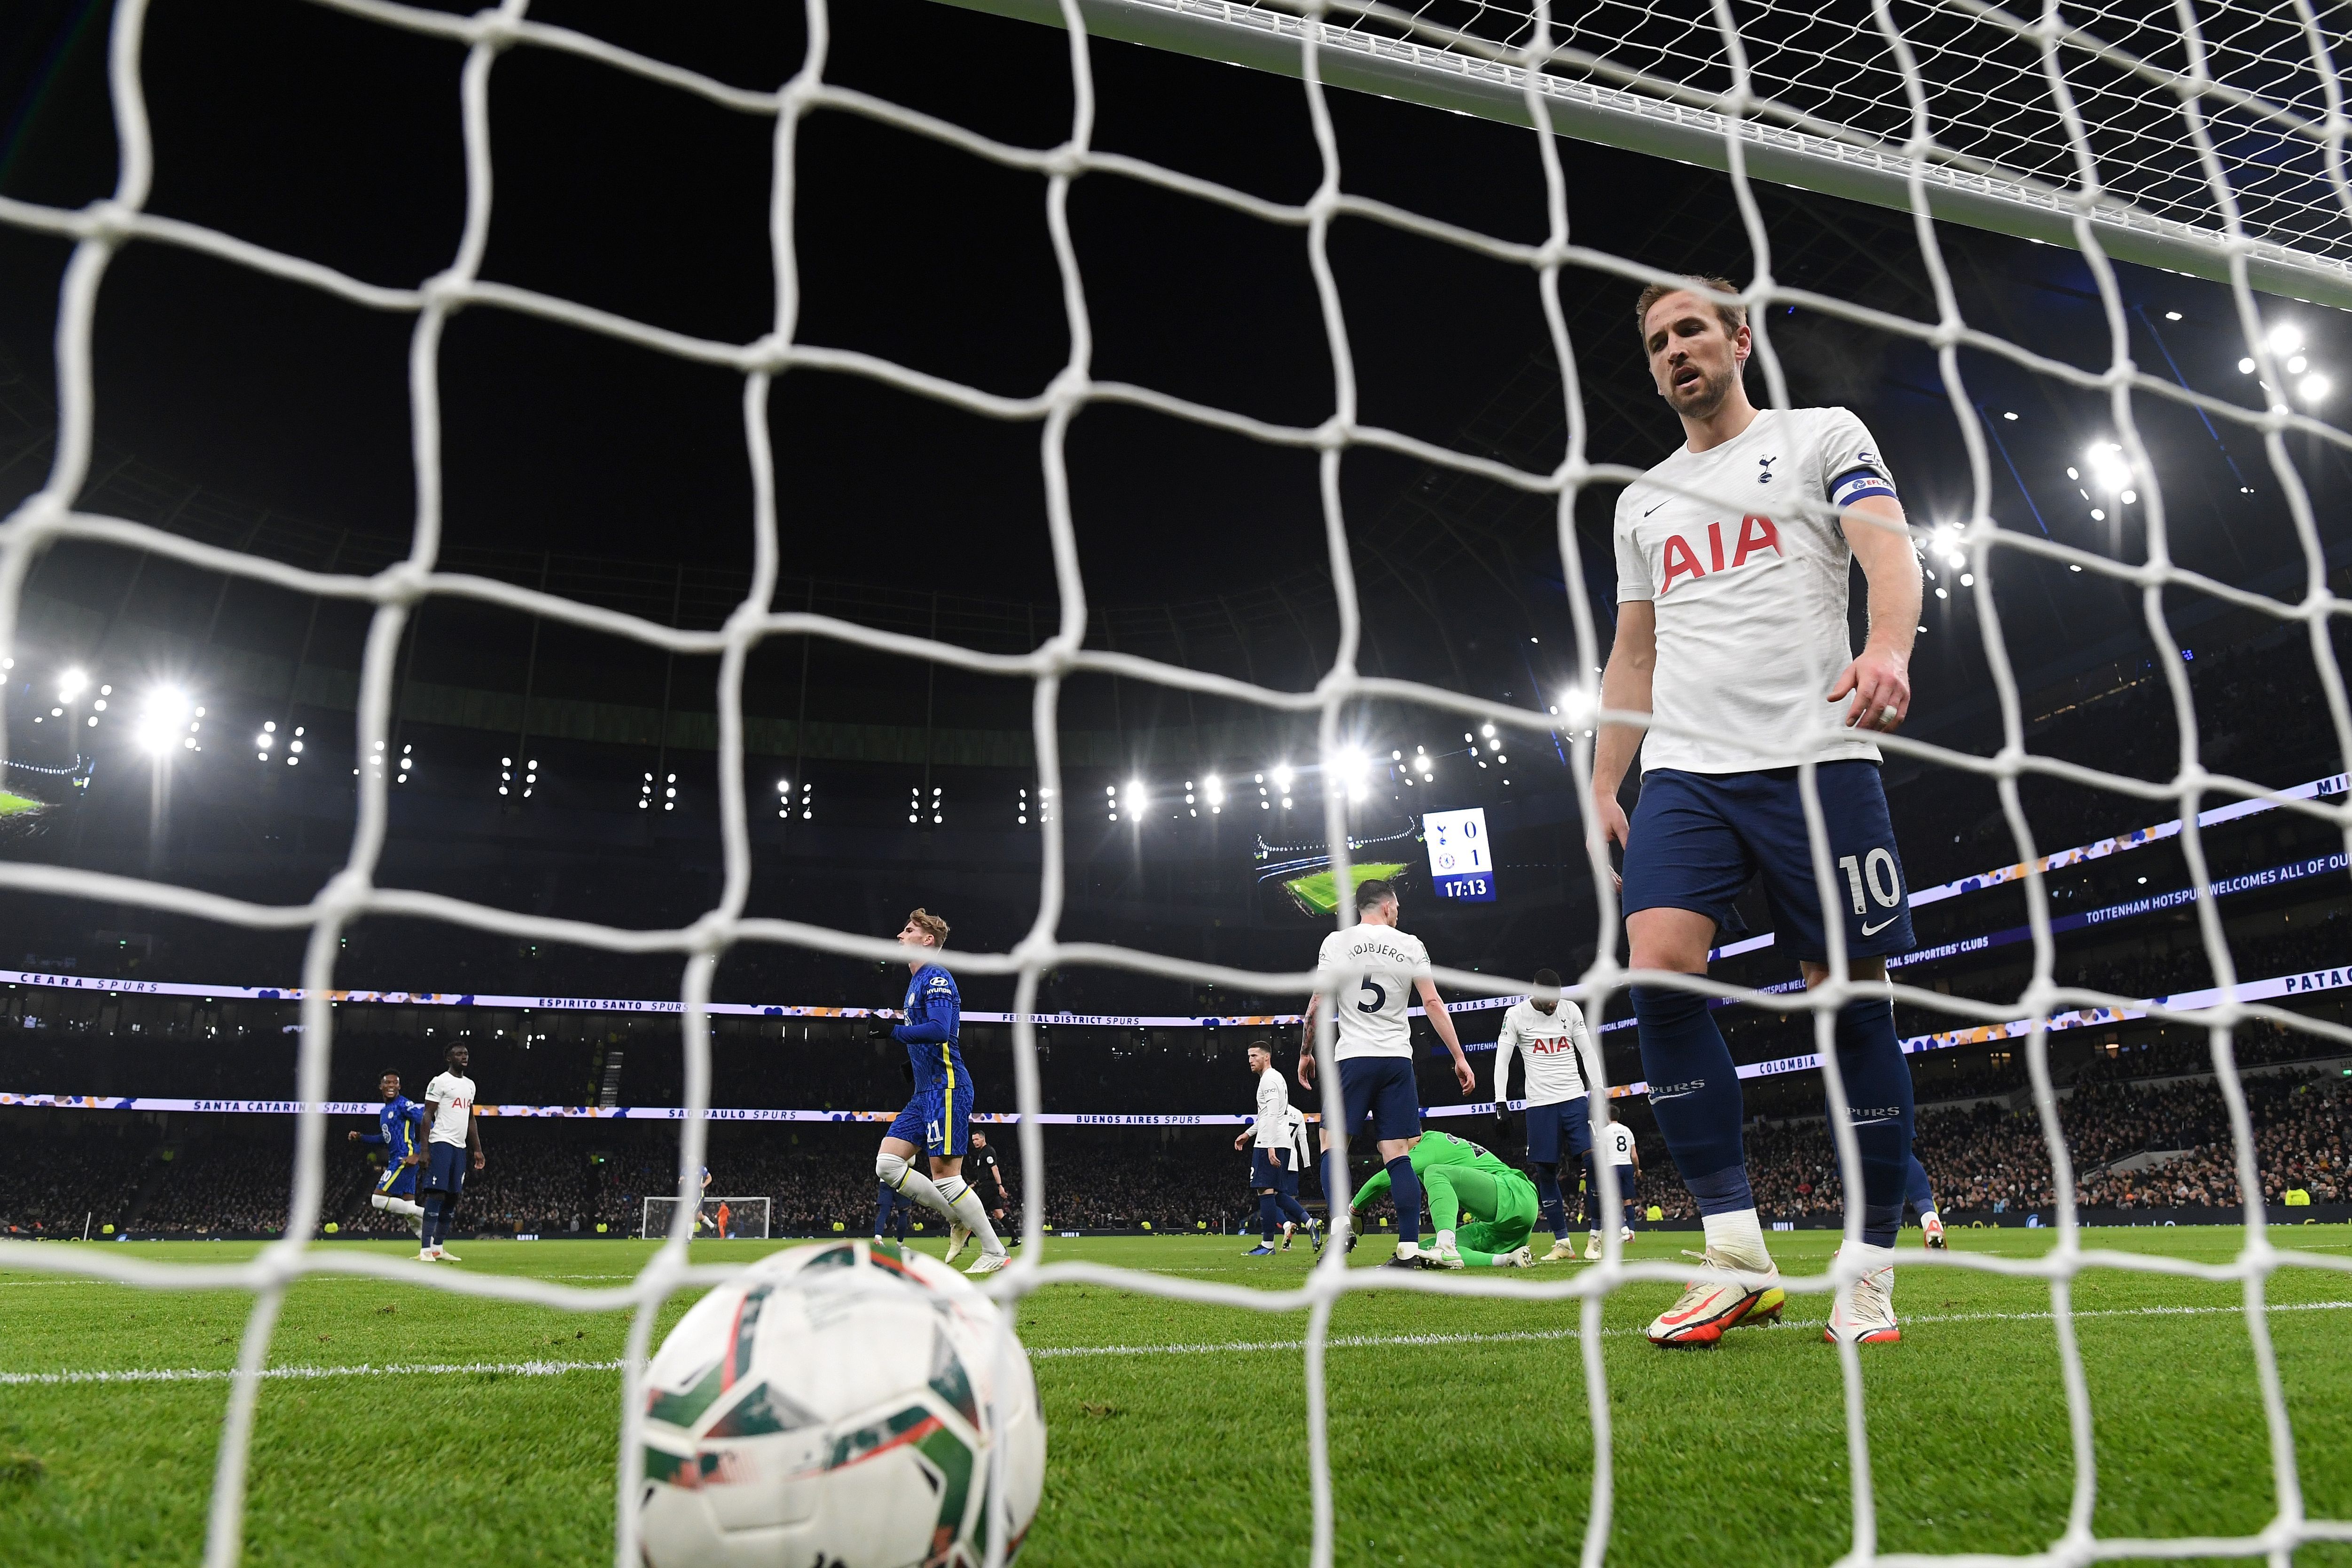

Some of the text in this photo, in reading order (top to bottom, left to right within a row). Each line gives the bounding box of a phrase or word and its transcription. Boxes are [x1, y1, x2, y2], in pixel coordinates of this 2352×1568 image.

[1661, 511, 1785, 595] AIA
[1464, 821, 1477, 839] 0
[1471, 849, 1479, 866] 1
[1445, 878, 1487, 897] 17:13
[1839, 848, 1900, 915] 10
[2086, 899, 2150, 924] TOTTENHAM
[2152, 887, 2204, 909] HOTSPUR
[2209, 870, 2276, 896] WELCOMES
[2280, 864, 2304, 880] ALL
[2307, 858, 2325, 874] OF
[1960, 936, 1989, 952] CLUBS
[21, 973, 158, 993] CEARA SPURS
[1357, 964, 1386, 1013] 5
[1758, 982, 1788, 996] HOTSPUR
[1788, 978, 1806, 990] WELC
[539, 999, 689, 1011] ESPIRITO SANTO SPURS
[1448, 1000, 1486, 1011] GOIAS
[1597, 1023, 1617, 1034] OFFICIAL
[1533, 1036, 1570, 1054] AIA
[1760, 1056, 1816, 1074] COLOMBIA
[194, 1101, 240, 1110] SANTA
[323, 1103, 368, 1113] SPURS
[703, 1110, 745, 1119] PAULO
[753, 1110, 796, 1120] SPURS
[1076, 1115, 1200, 1124] BUENOS AIRES SPURS
[1616, 1135, 1627, 1152] 8
